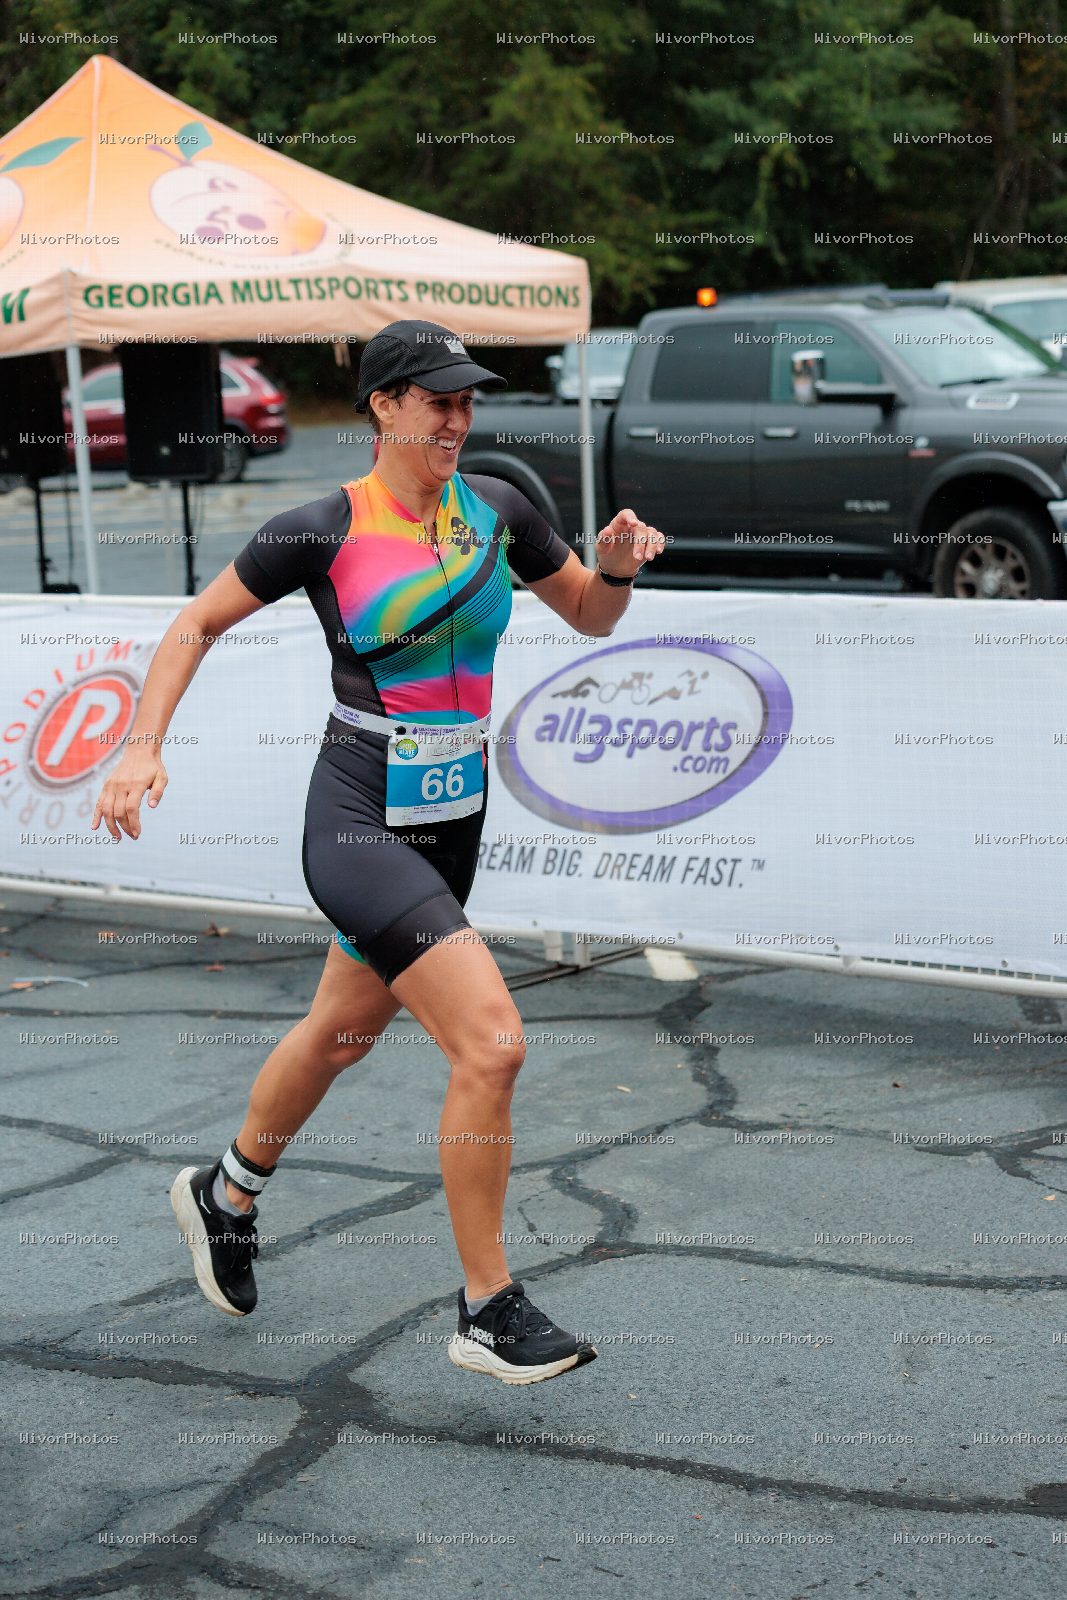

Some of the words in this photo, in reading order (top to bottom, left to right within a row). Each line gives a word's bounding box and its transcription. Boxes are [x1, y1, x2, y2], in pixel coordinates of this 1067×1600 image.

[83, 281, 224, 308] GEORGIA
[230, 276, 409, 304] MULTISPORTS
[415, 281, 580, 308] PRODUCTIONS
[534, 706, 738, 763] all3sports
[421, 763, 464, 801] 66
[672, 754, 730, 775] .com
[479, 842, 536, 874] REAM
[542, 847, 582, 878] BIG.
[593, 852, 677, 884] DREAM
[680, 856, 743, 888] FAST.
